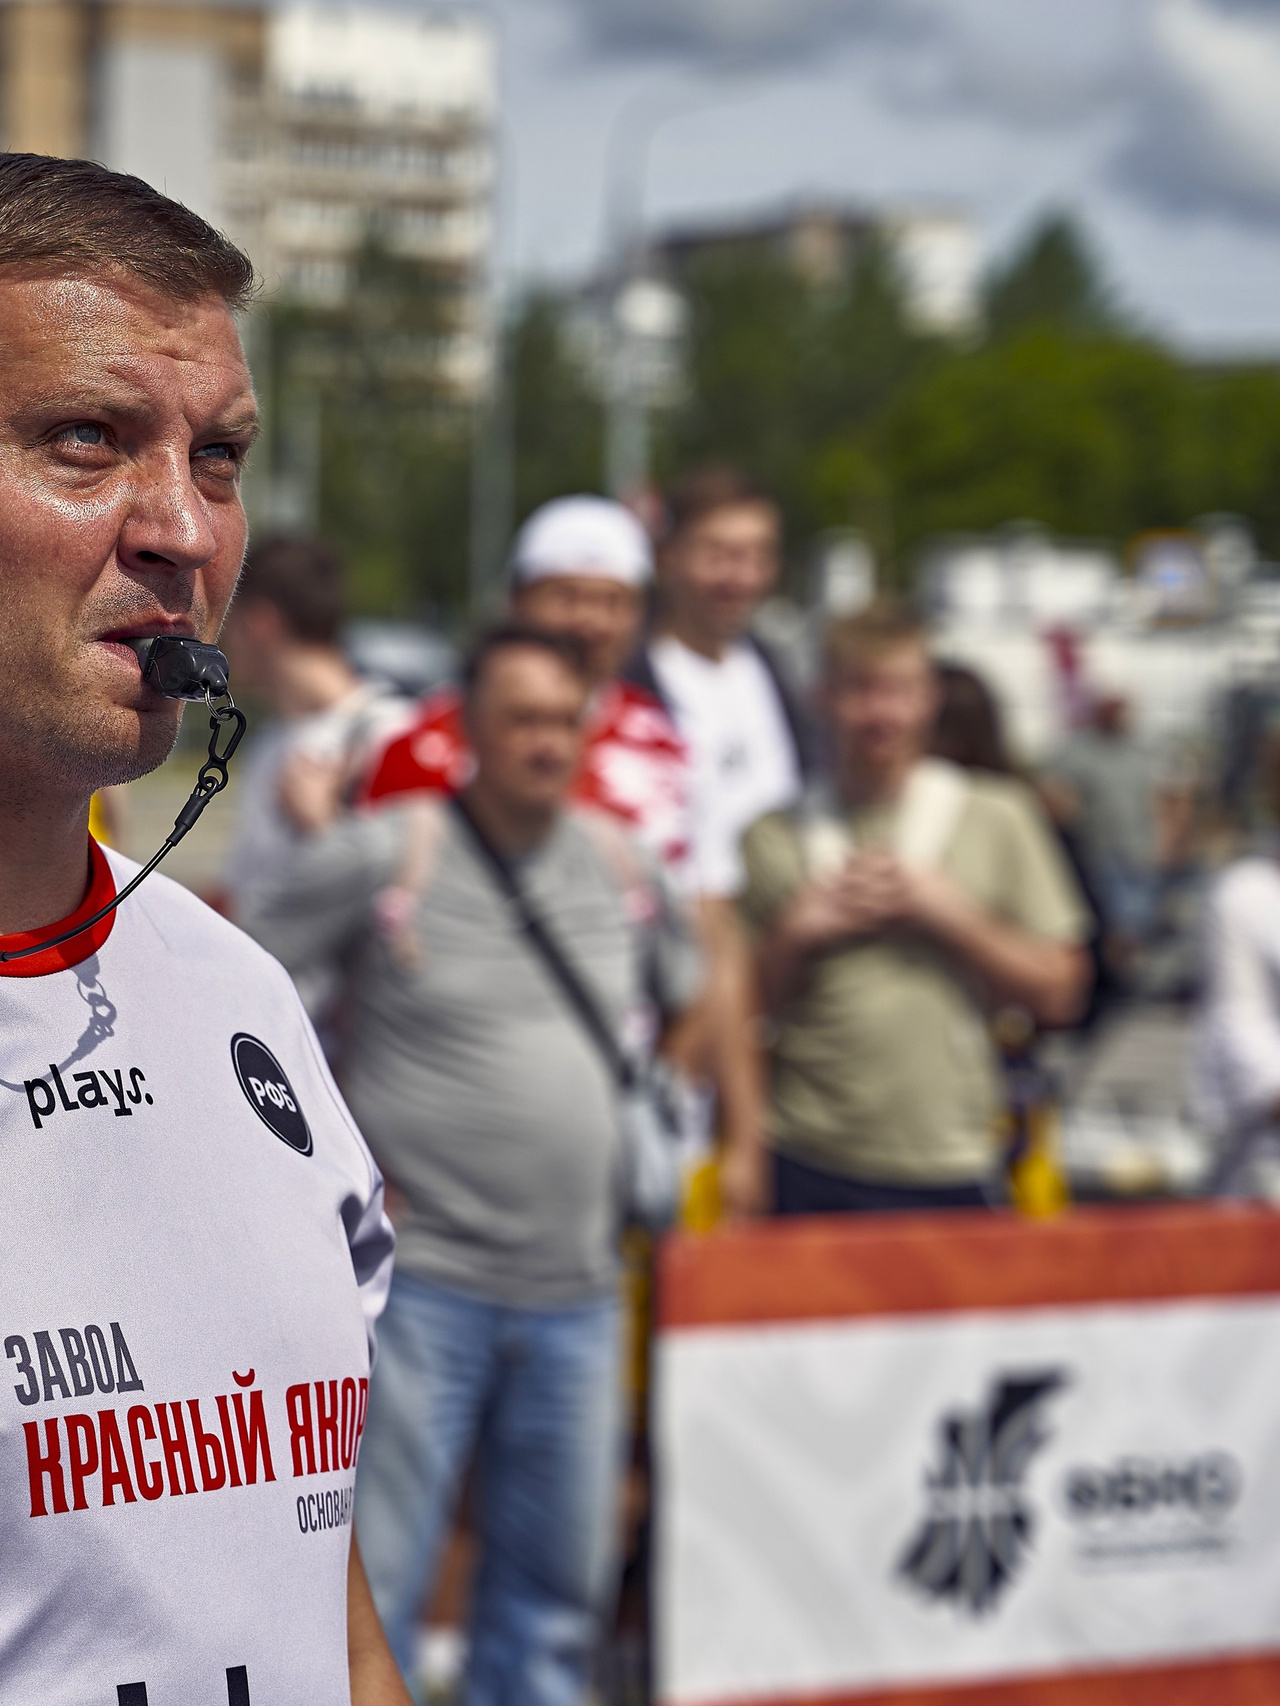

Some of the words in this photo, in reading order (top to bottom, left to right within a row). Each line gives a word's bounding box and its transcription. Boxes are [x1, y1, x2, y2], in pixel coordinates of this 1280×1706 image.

[247, 1076, 297, 1113] РФБ
[4, 1321, 145, 1406] ЗАВОД
[22, 1368, 277, 1518] КРАСНЫЙ
